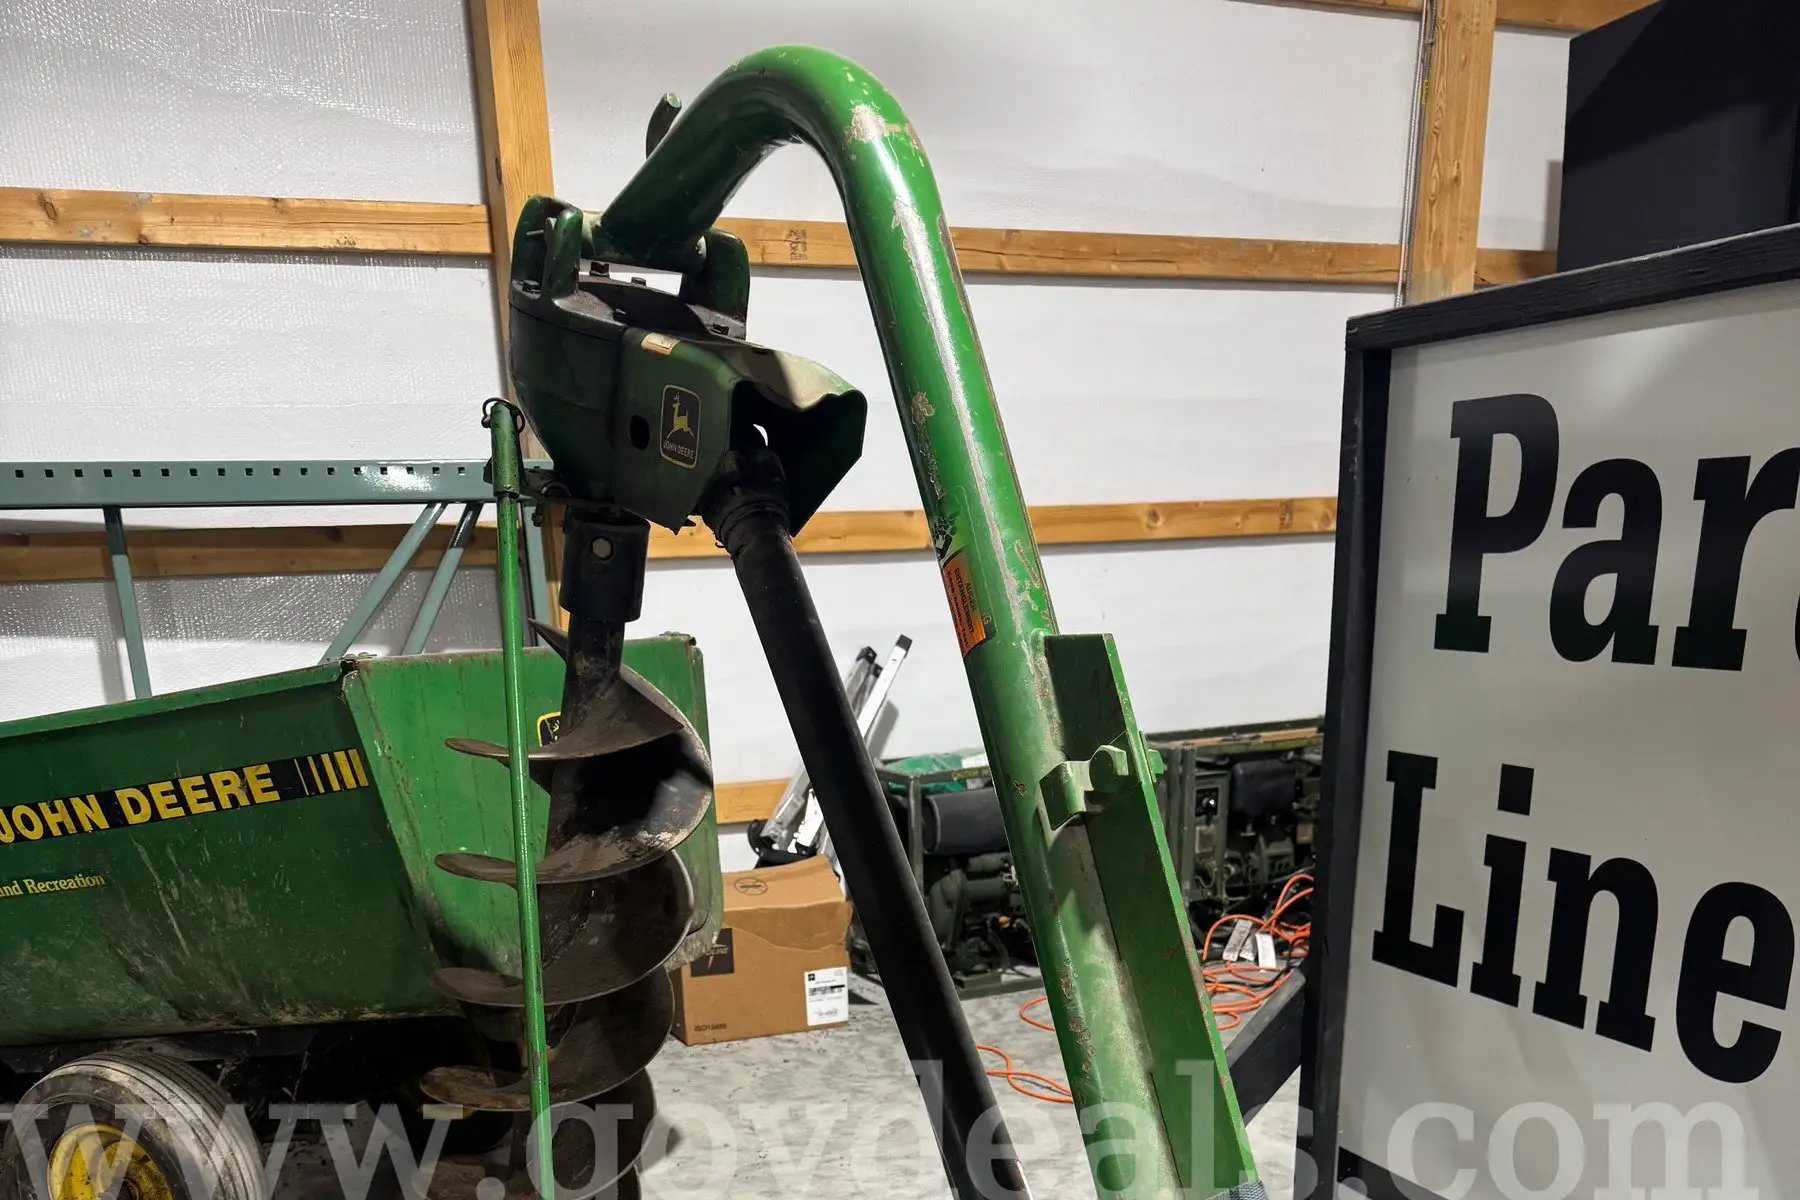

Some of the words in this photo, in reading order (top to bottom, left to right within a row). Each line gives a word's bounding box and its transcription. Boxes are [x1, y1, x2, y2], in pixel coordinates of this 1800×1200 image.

[677, 445, 695, 460] DEERE
[1434, 393, 1800, 671] Par
[114, 763, 281, 825] DEERE
[23, 873, 106, 894] Recreation
[1372, 750, 1796, 1084] Line
